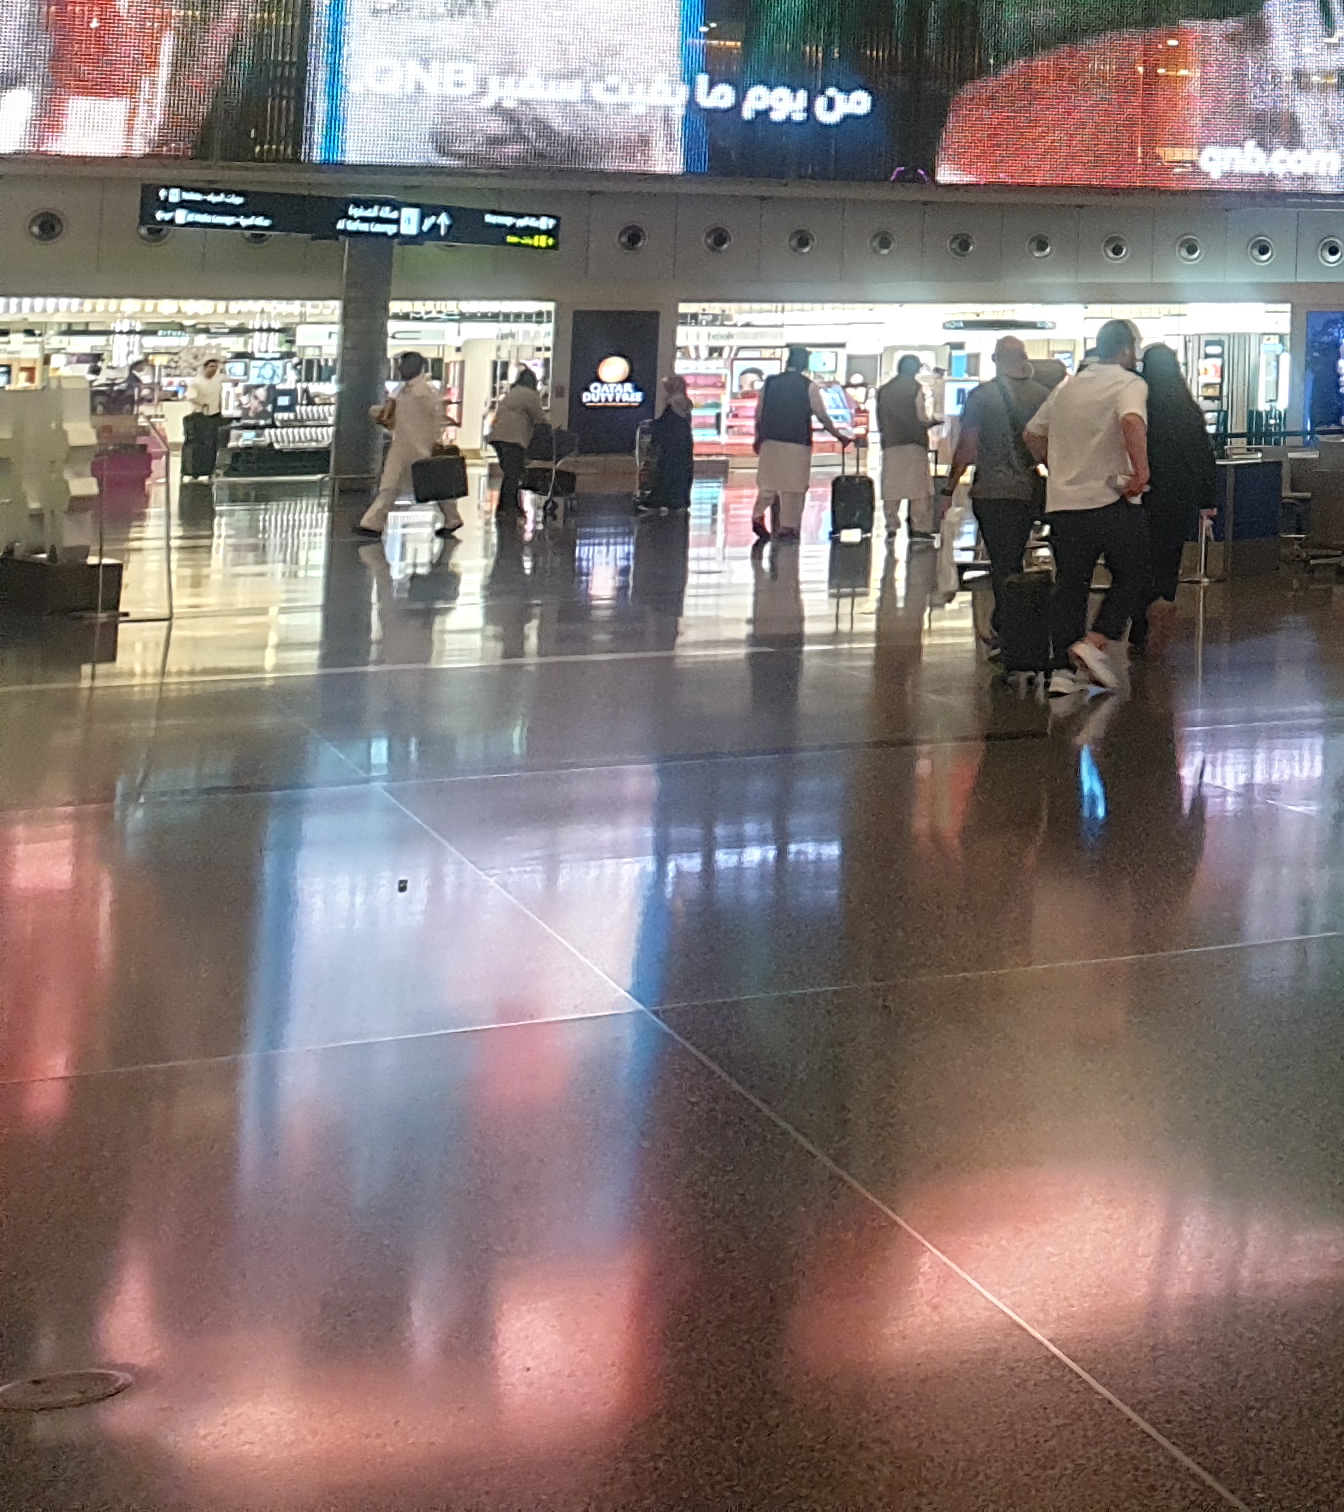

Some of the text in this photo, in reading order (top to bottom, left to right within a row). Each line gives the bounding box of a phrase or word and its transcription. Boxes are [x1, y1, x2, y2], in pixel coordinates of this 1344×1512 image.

[693, 72, 735, 112] ما
[741, 83, 809, 123] يوم
[813, 88, 873, 126] من
[1199, 139, 1341, 179] qnb.com
[582, 392, 615, 403] DUTY
[589, 382, 634, 394] QATAR
